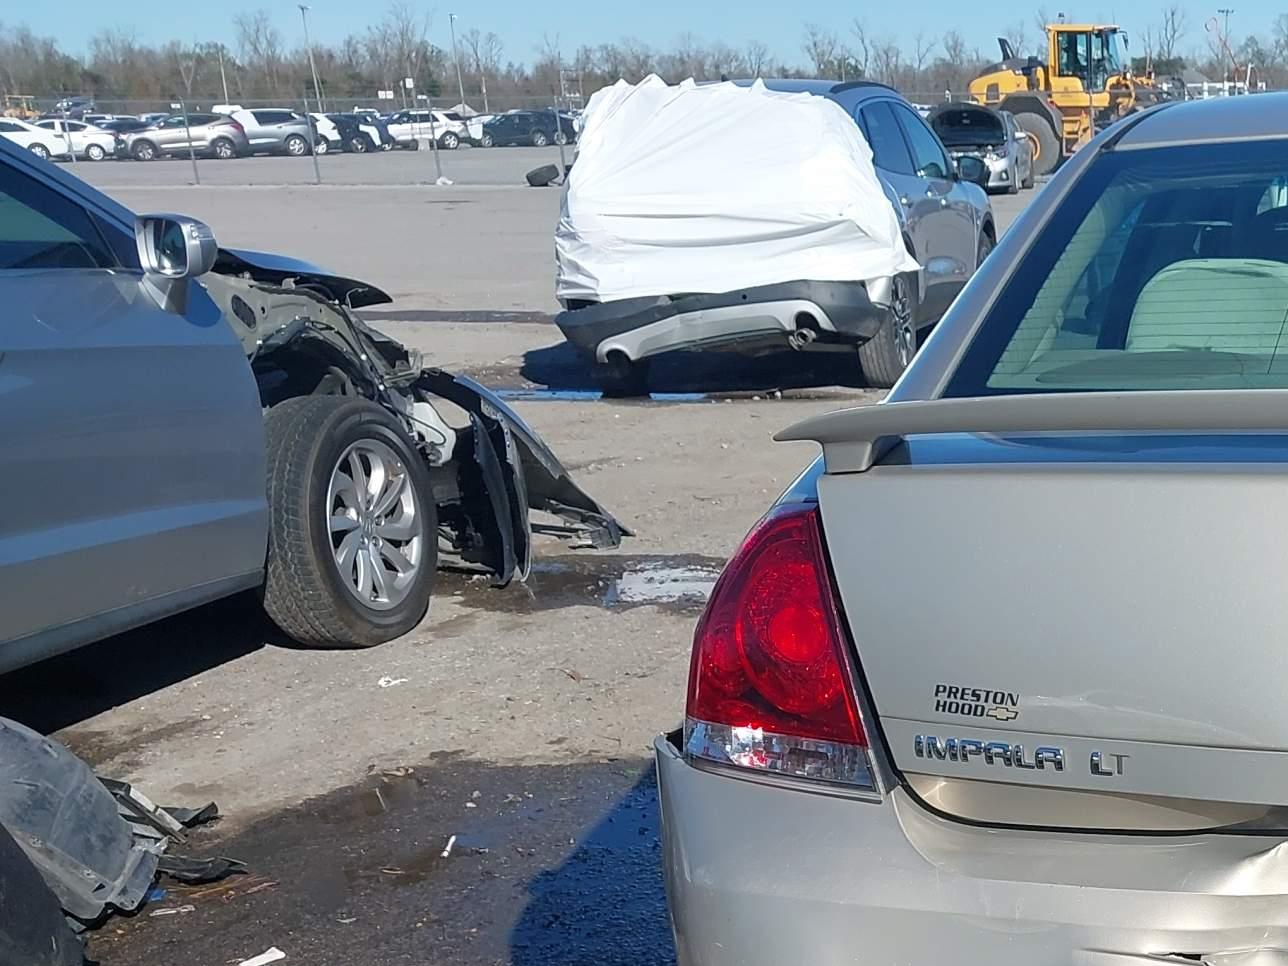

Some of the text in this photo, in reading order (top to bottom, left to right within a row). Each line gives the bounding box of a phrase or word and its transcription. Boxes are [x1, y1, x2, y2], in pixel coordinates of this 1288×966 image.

[934, 684, 1019, 707] PRESTON
[935, 700, 985, 717] HOOD
[914, 735, 1130, 776] IMPALA LT
